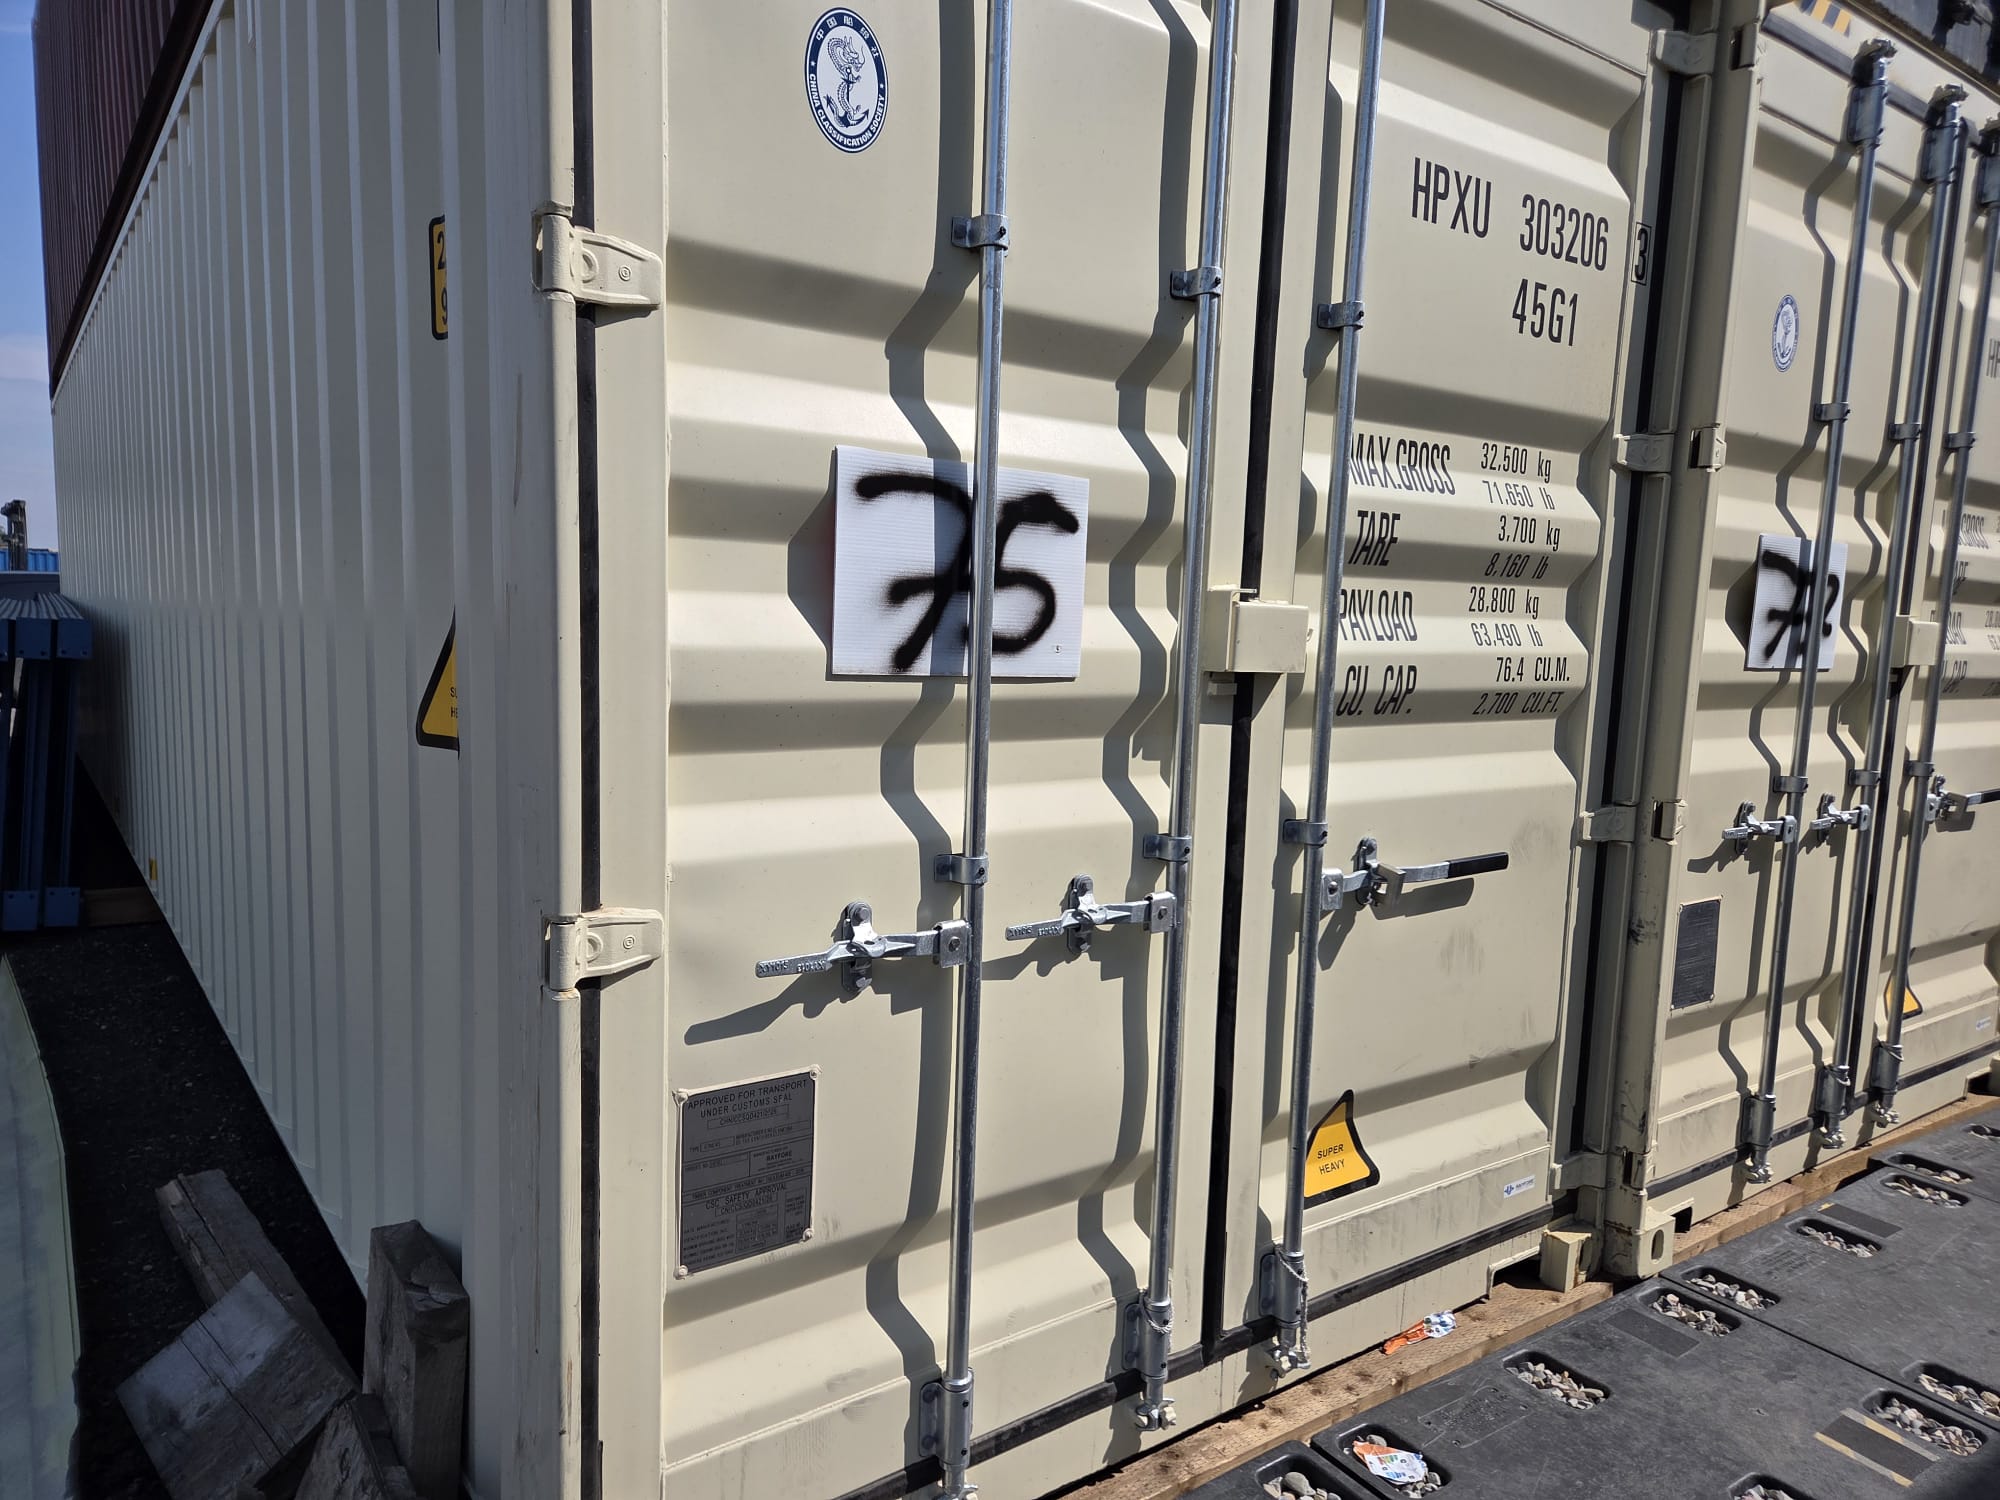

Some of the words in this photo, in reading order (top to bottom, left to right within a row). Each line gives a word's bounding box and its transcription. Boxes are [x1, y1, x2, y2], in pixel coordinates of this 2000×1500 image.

[809, 74, 821, 107] CHINA
[817, 109, 873, 147] CLASSIFICATION
[870, 94, 885, 133] SOCIETY
[1411, 156, 1492, 239] HPXU
[1519, 193, 1610, 272] 303206
[1633, 226, 1649, 282] 3
[1511, 278, 1579, 347] 45G1
[1350, 433, 1456, 496] MAX.GROSS
[1481, 442, 1528, 475] 32,500
[1537, 451, 1552, 484] kg
[1482, 480, 1534, 508] 71,650
[1538, 486, 1556, 510] lb
[1348, 510, 1401, 567] TARE
[1498, 515, 1537, 544] 3,700
[1546, 520, 1561, 552] kg
[854, 472, 1080, 672] 75
[1484, 552, 1531, 578] 8,160
[1532, 555, 1550, 580] lb
[1339, 589, 1418, 642] PAYLOAD
[1469, 586, 1516, 614] 28,800
[1525, 589, 1540, 620] kg
[1471, 622, 1522, 647] 63,490
[1527, 624, 1544, 647] lb
[1336, 665, 1369, 716] CU.
[1374, 665, 1418, 715] CAP.
[1496, 657, 1525, 682] 76.4
[1534, 657, 1571, 682] CU.M.
[1472, 692, 1519, 715] 2,700
[688, 1093, 736, 1110] APPROVED
[738, 1089, 756, 1100] FOR
[759, 1080, 807, 1096] TRANSPORT
[701, 1105, 729, 1118] UNDER
[732, 1098, 771, 1112] CUSTOMS
[773, 1092, 793, 1104] SEAL
[1317, 1143, 1344, 1159] SUPER
[1319, 1158, 1345, 1175] HEAVY
[705, 1200, 720, 1210] CSC
[725, 1191, 750, 1206] SAFETY
